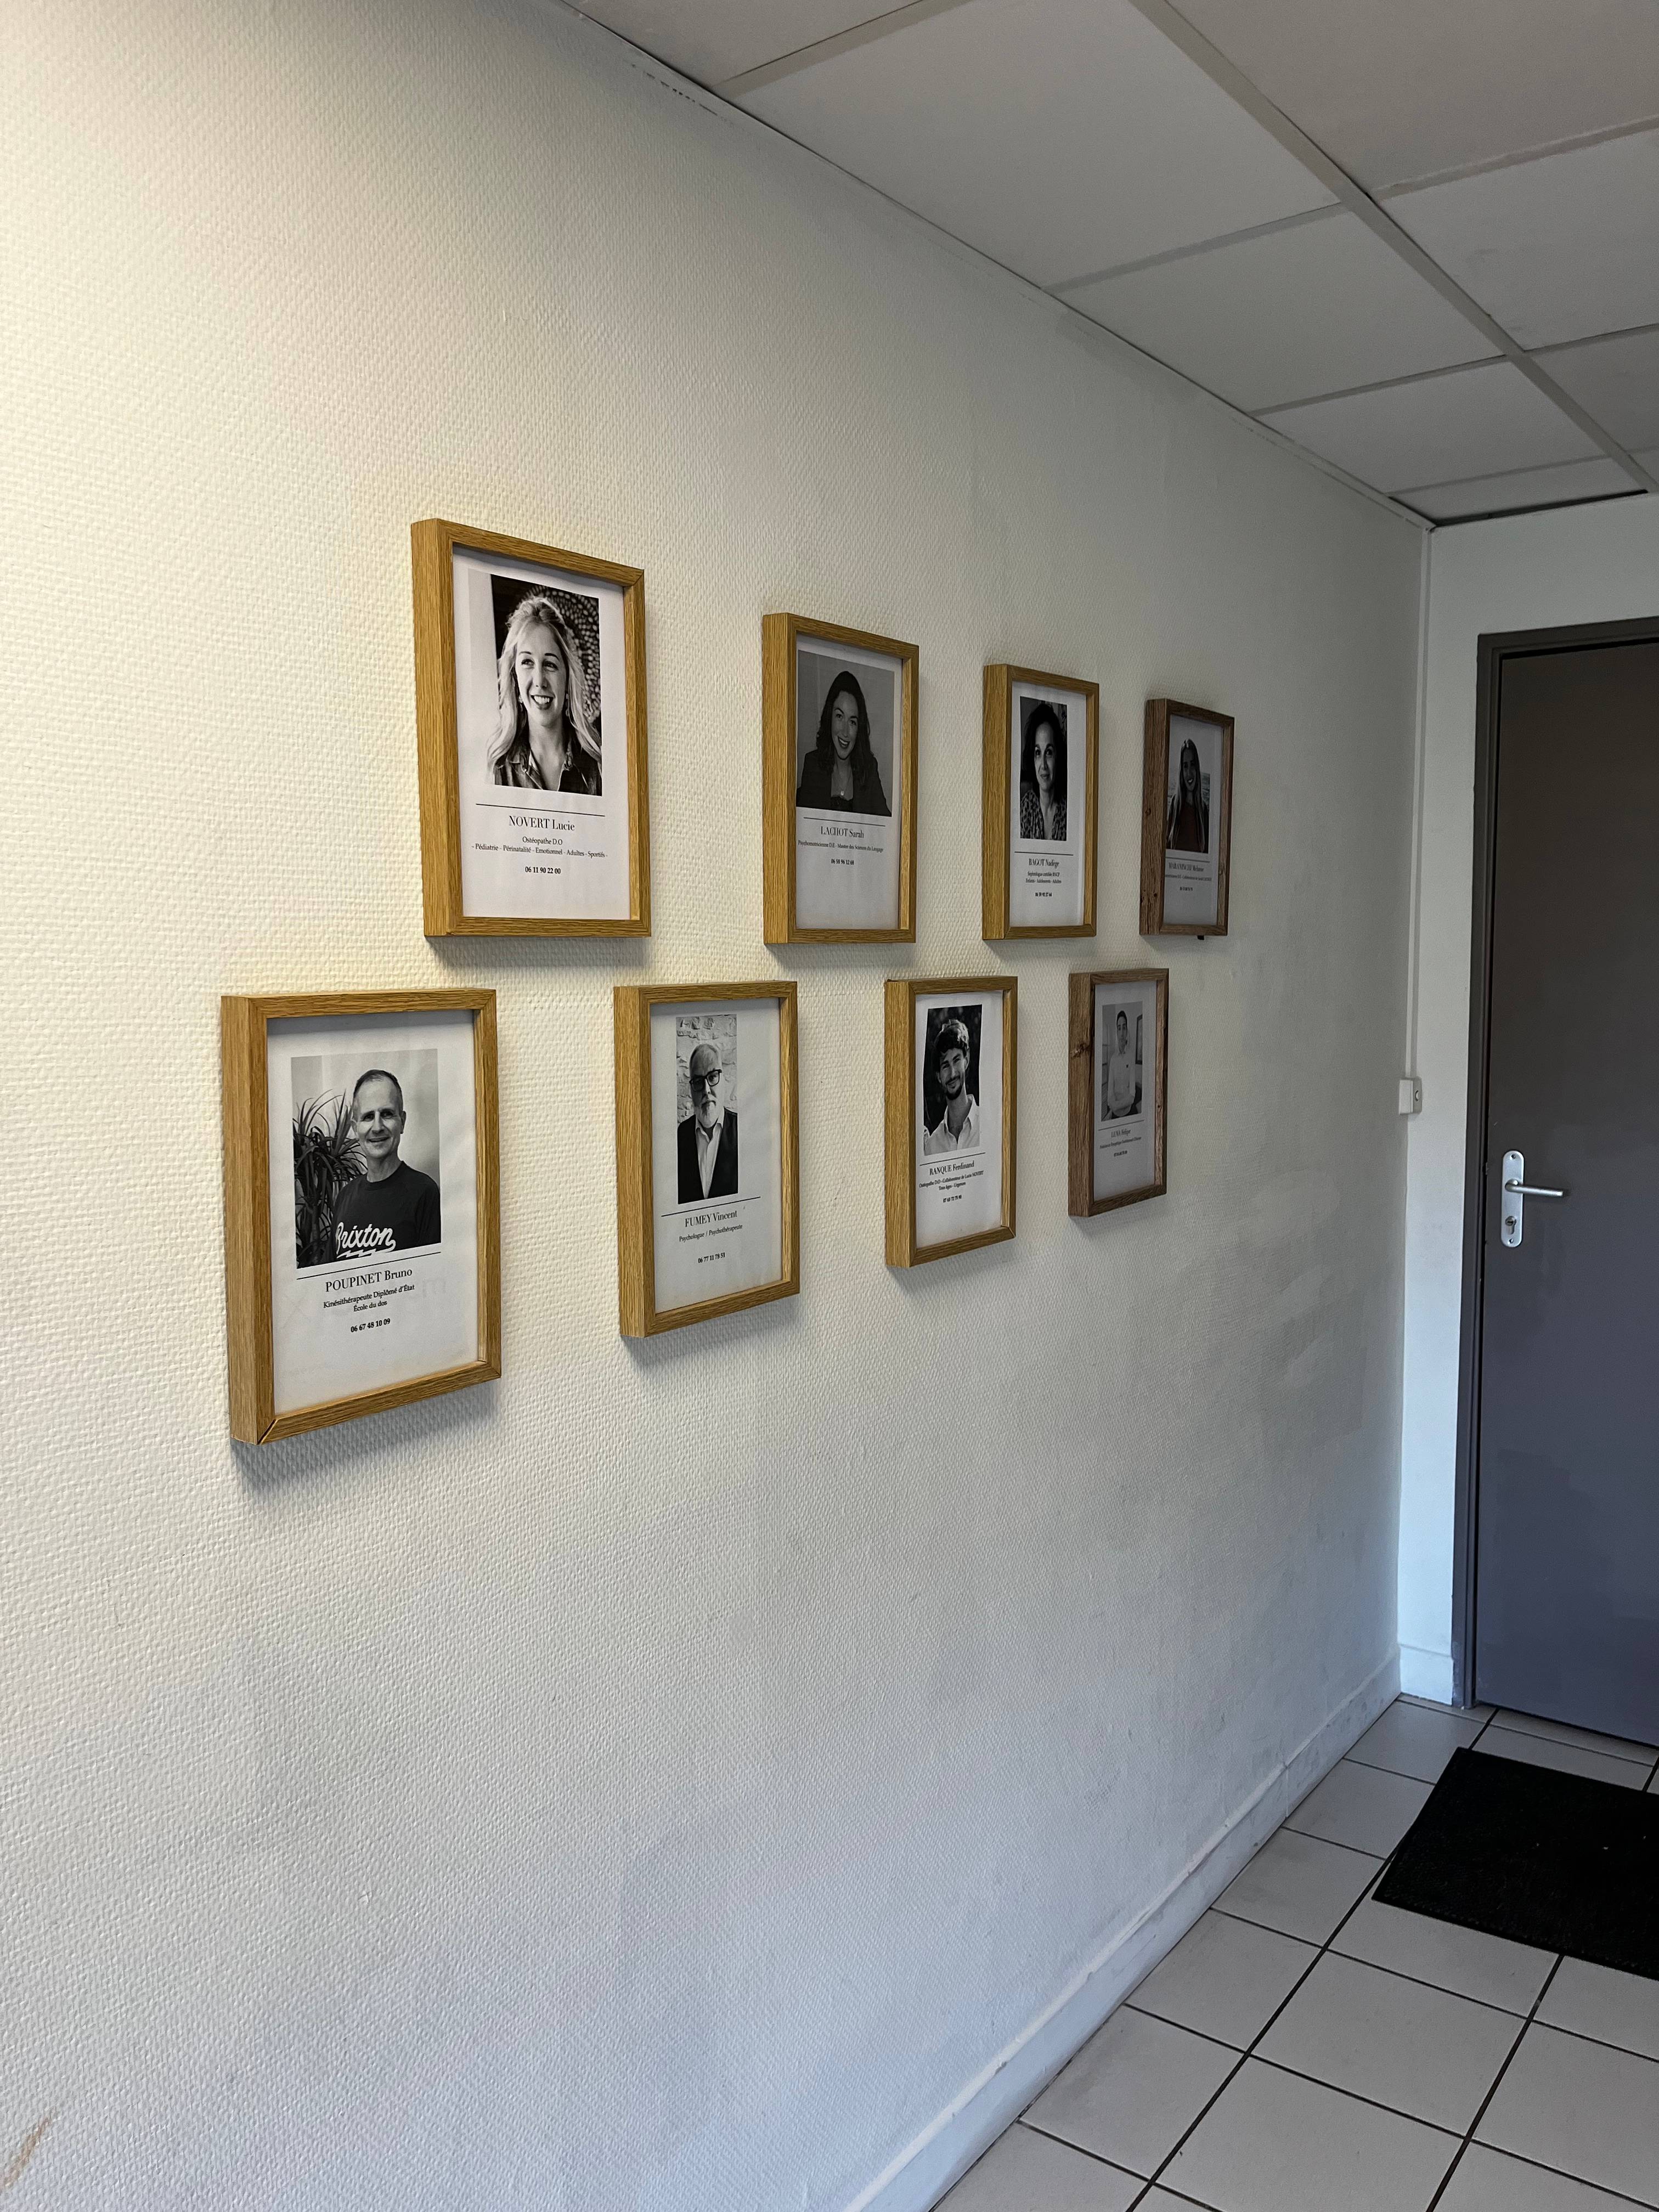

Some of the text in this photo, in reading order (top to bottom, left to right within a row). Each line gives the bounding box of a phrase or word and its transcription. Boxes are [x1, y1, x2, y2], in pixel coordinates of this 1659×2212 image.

[509, 815, 575, 831] NOVERT Lucie
[821, 826, 865, 839] LACHOT Sarah
[503, 845, 532, 853] Périnatalité
[522, 836, 551, 847] Ostéopathe
[929, 1160, 974, 1176] RANQUE Ferdinand
[685, 1210, 737, 1227] FUMEY Vincent
[336, 1222, 396, 1255] Brixton
[679, 1232, 705, 1243] Psychologue
[709, 1224, 743, 1237] Psychothérapeute
[325, 1269, 412, 1292] POUPINET Bruno
[323, 1292, 373, 1308] Kinésithérapeute
[373, 1288, 397, 1298] Diplômé
[353, 1304, 368, 1312] École
